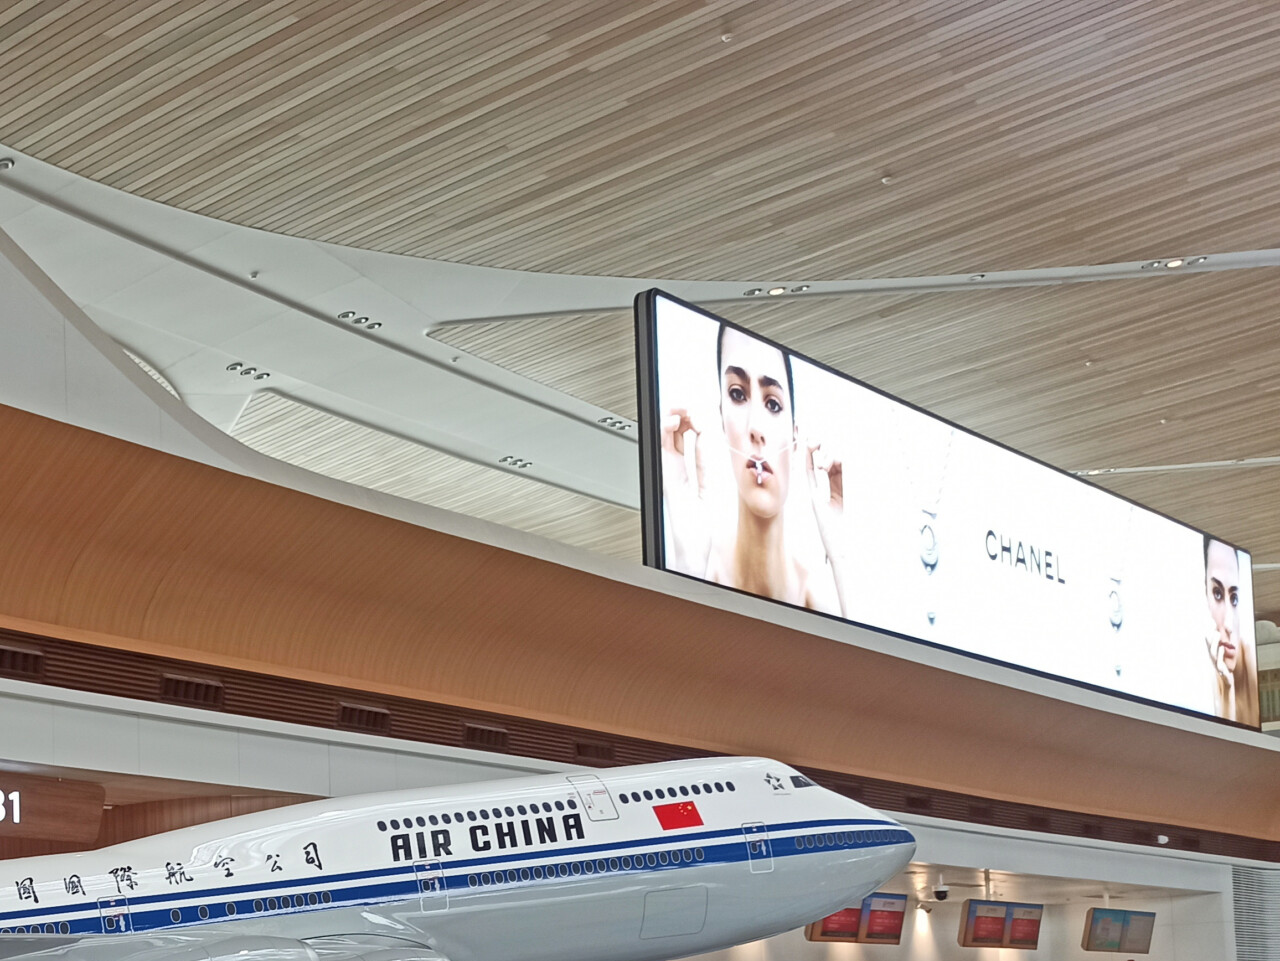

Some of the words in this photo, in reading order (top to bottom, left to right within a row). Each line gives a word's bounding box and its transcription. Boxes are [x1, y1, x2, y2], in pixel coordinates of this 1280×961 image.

[985, 530, 1066, 584] CHANEL
[390, 829, 453, 861] AIR
[469, 813, 585, 852] CHINA
